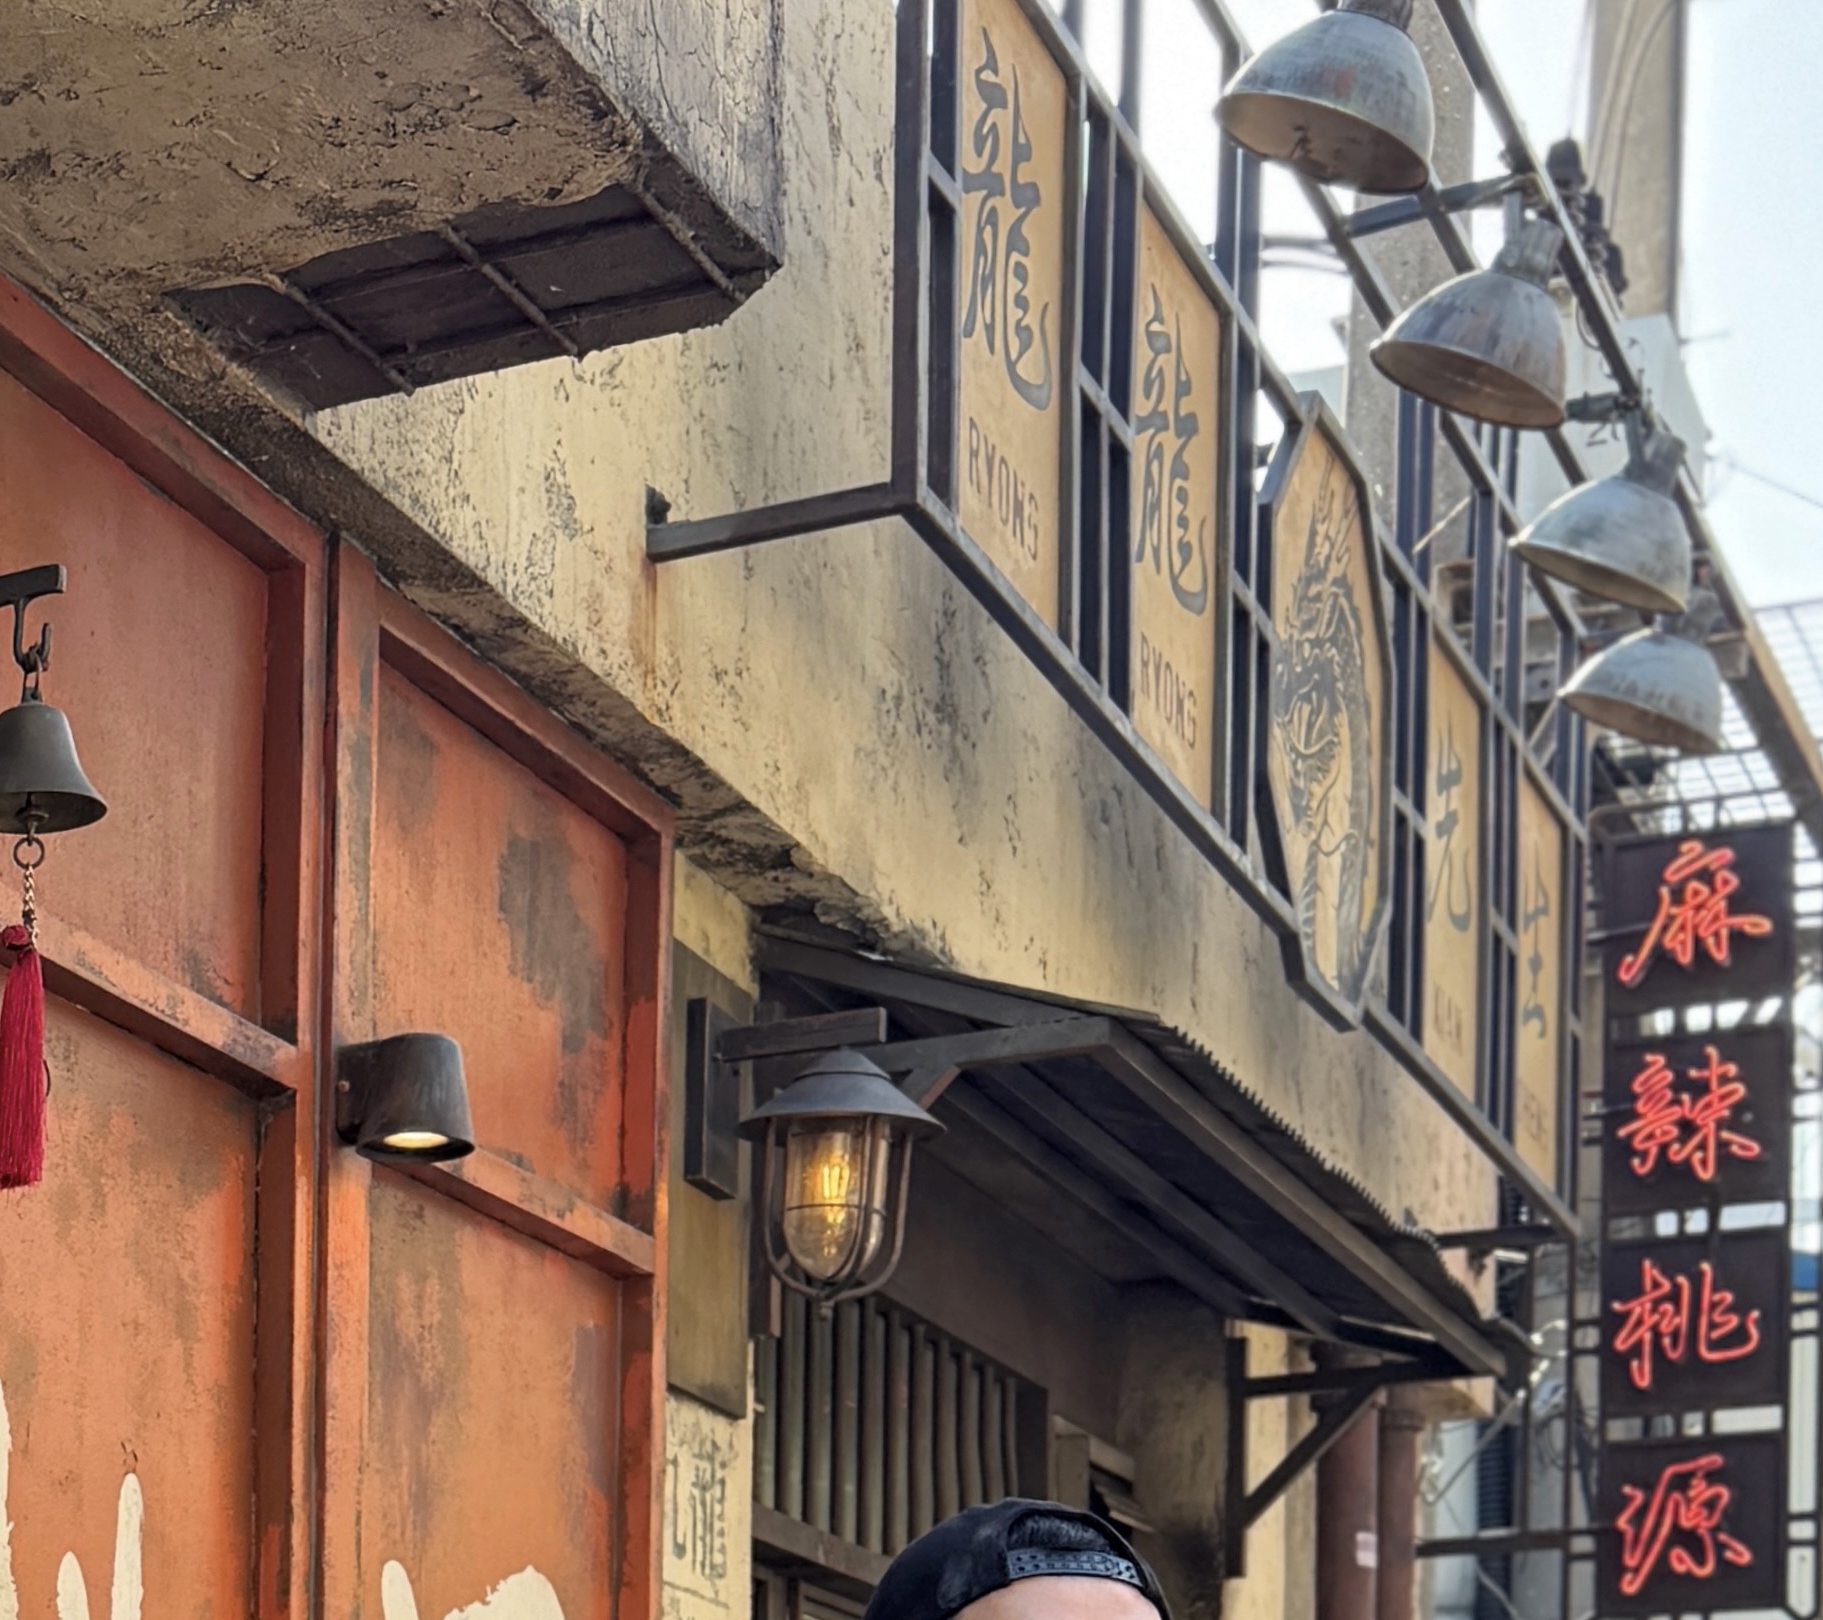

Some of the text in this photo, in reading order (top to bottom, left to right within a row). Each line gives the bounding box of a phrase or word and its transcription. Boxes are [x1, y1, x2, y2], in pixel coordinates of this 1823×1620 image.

[962, 25, 1053, 412] 龍
[1134, 281, 1208, 617] 龍
[1140, 630, 1198, 751] RYONG
[1612, 841, 1775, 1596] 麻辣桃源
